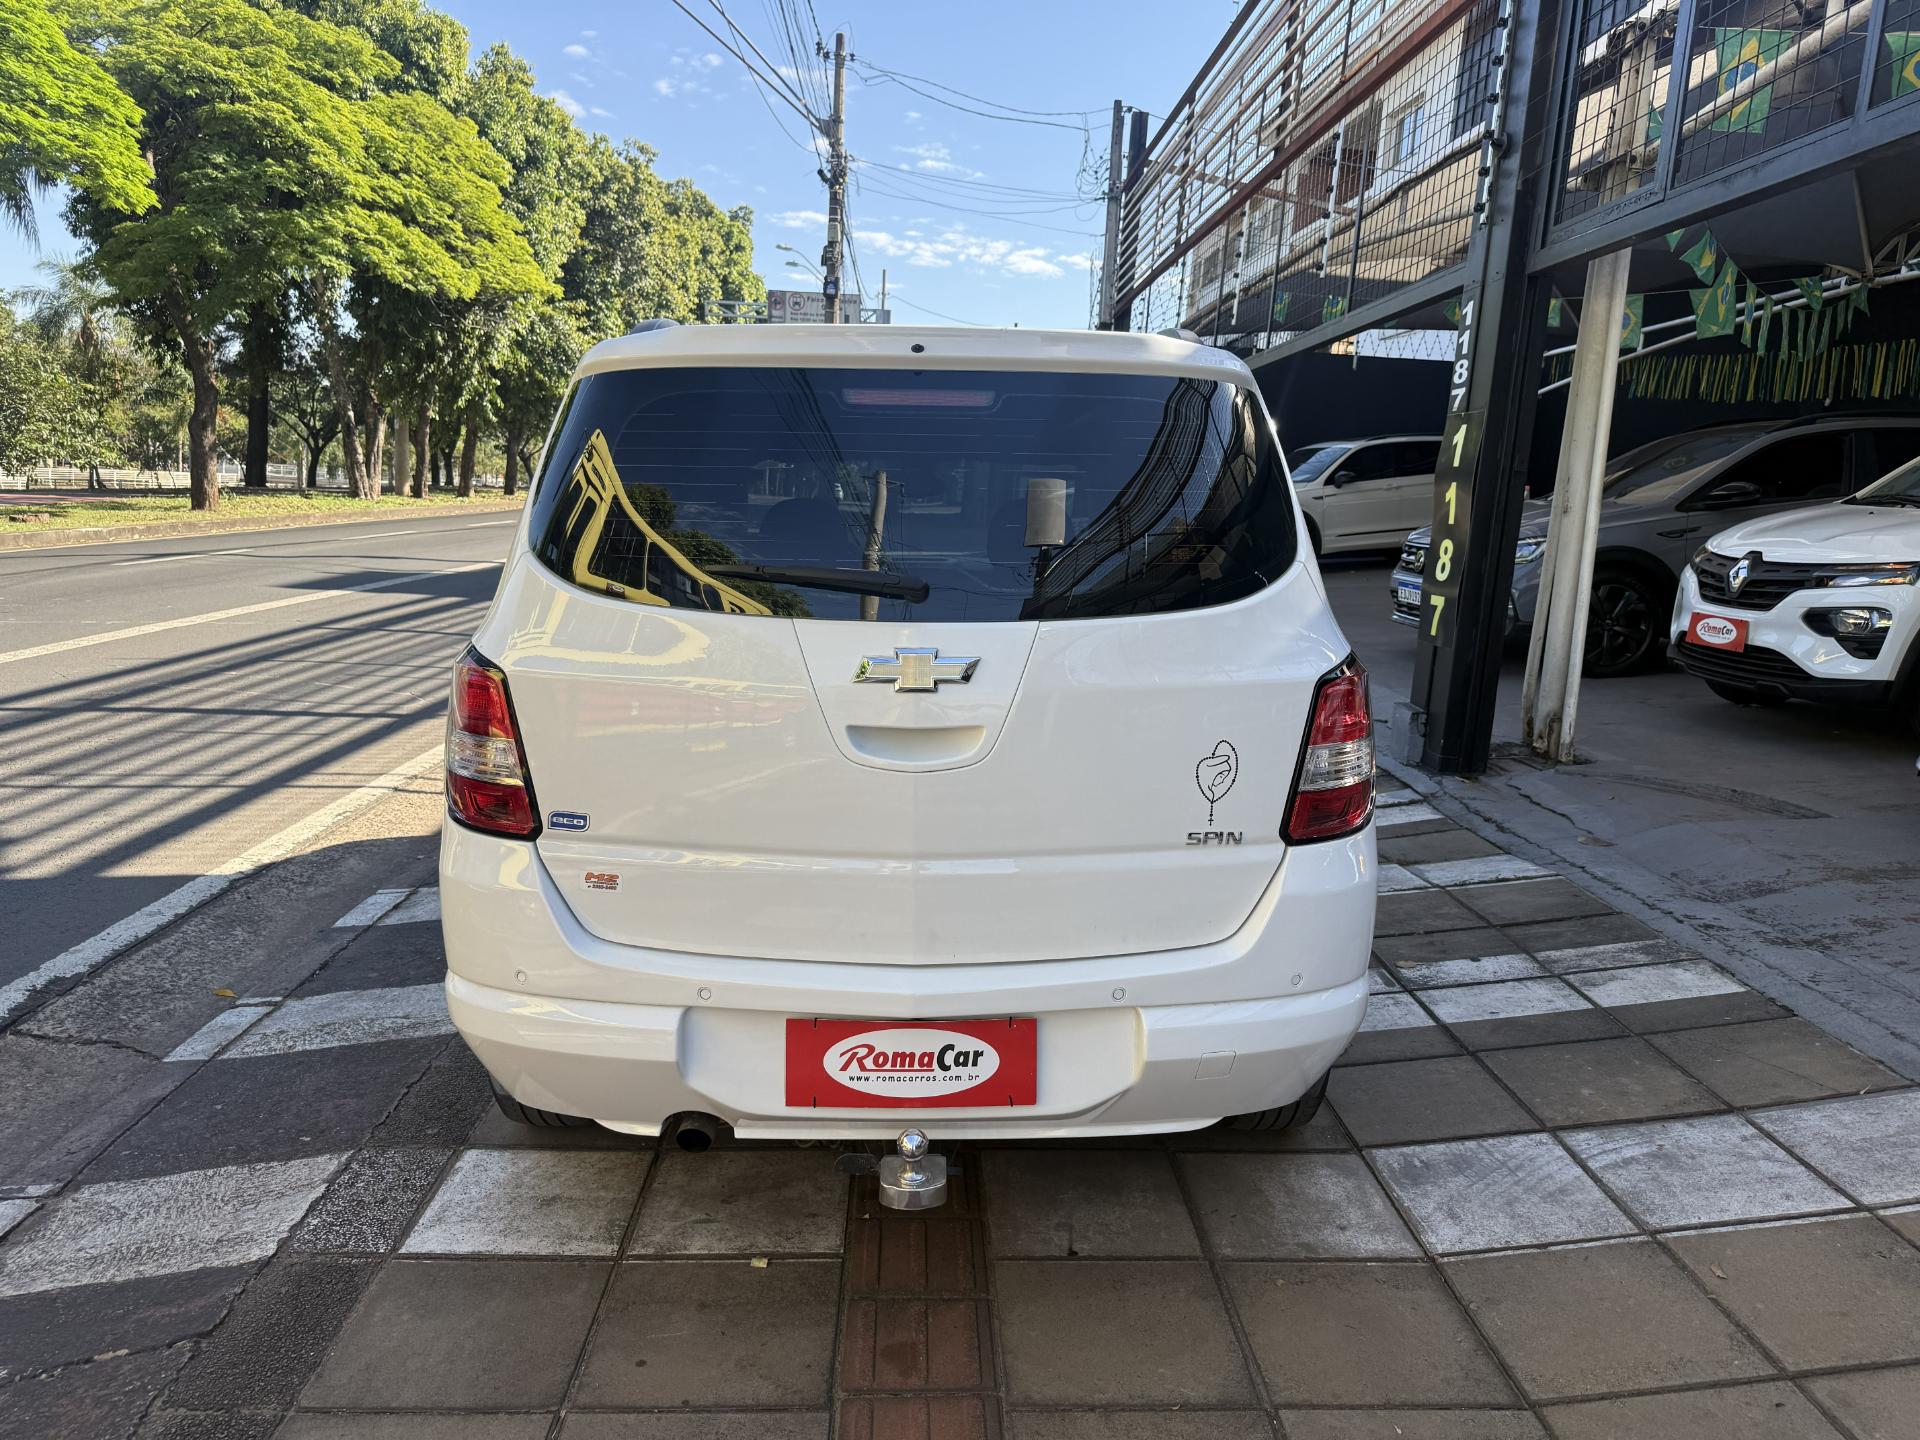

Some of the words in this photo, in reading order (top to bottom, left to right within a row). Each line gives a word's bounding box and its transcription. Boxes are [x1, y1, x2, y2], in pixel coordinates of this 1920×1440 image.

[1451, 300, 1475, 412] 1187
[1429, 423, 1468, 637] 1187
[1699, 621, 1734, 636] RomaCar
[552, 816, 585, 826] eco
[1185, 831, 1243, 846] SPIN
[838, 1043, 984, 1073] RomaCar
[848, 1073, 980, 1083] www.romacarros.com.br
